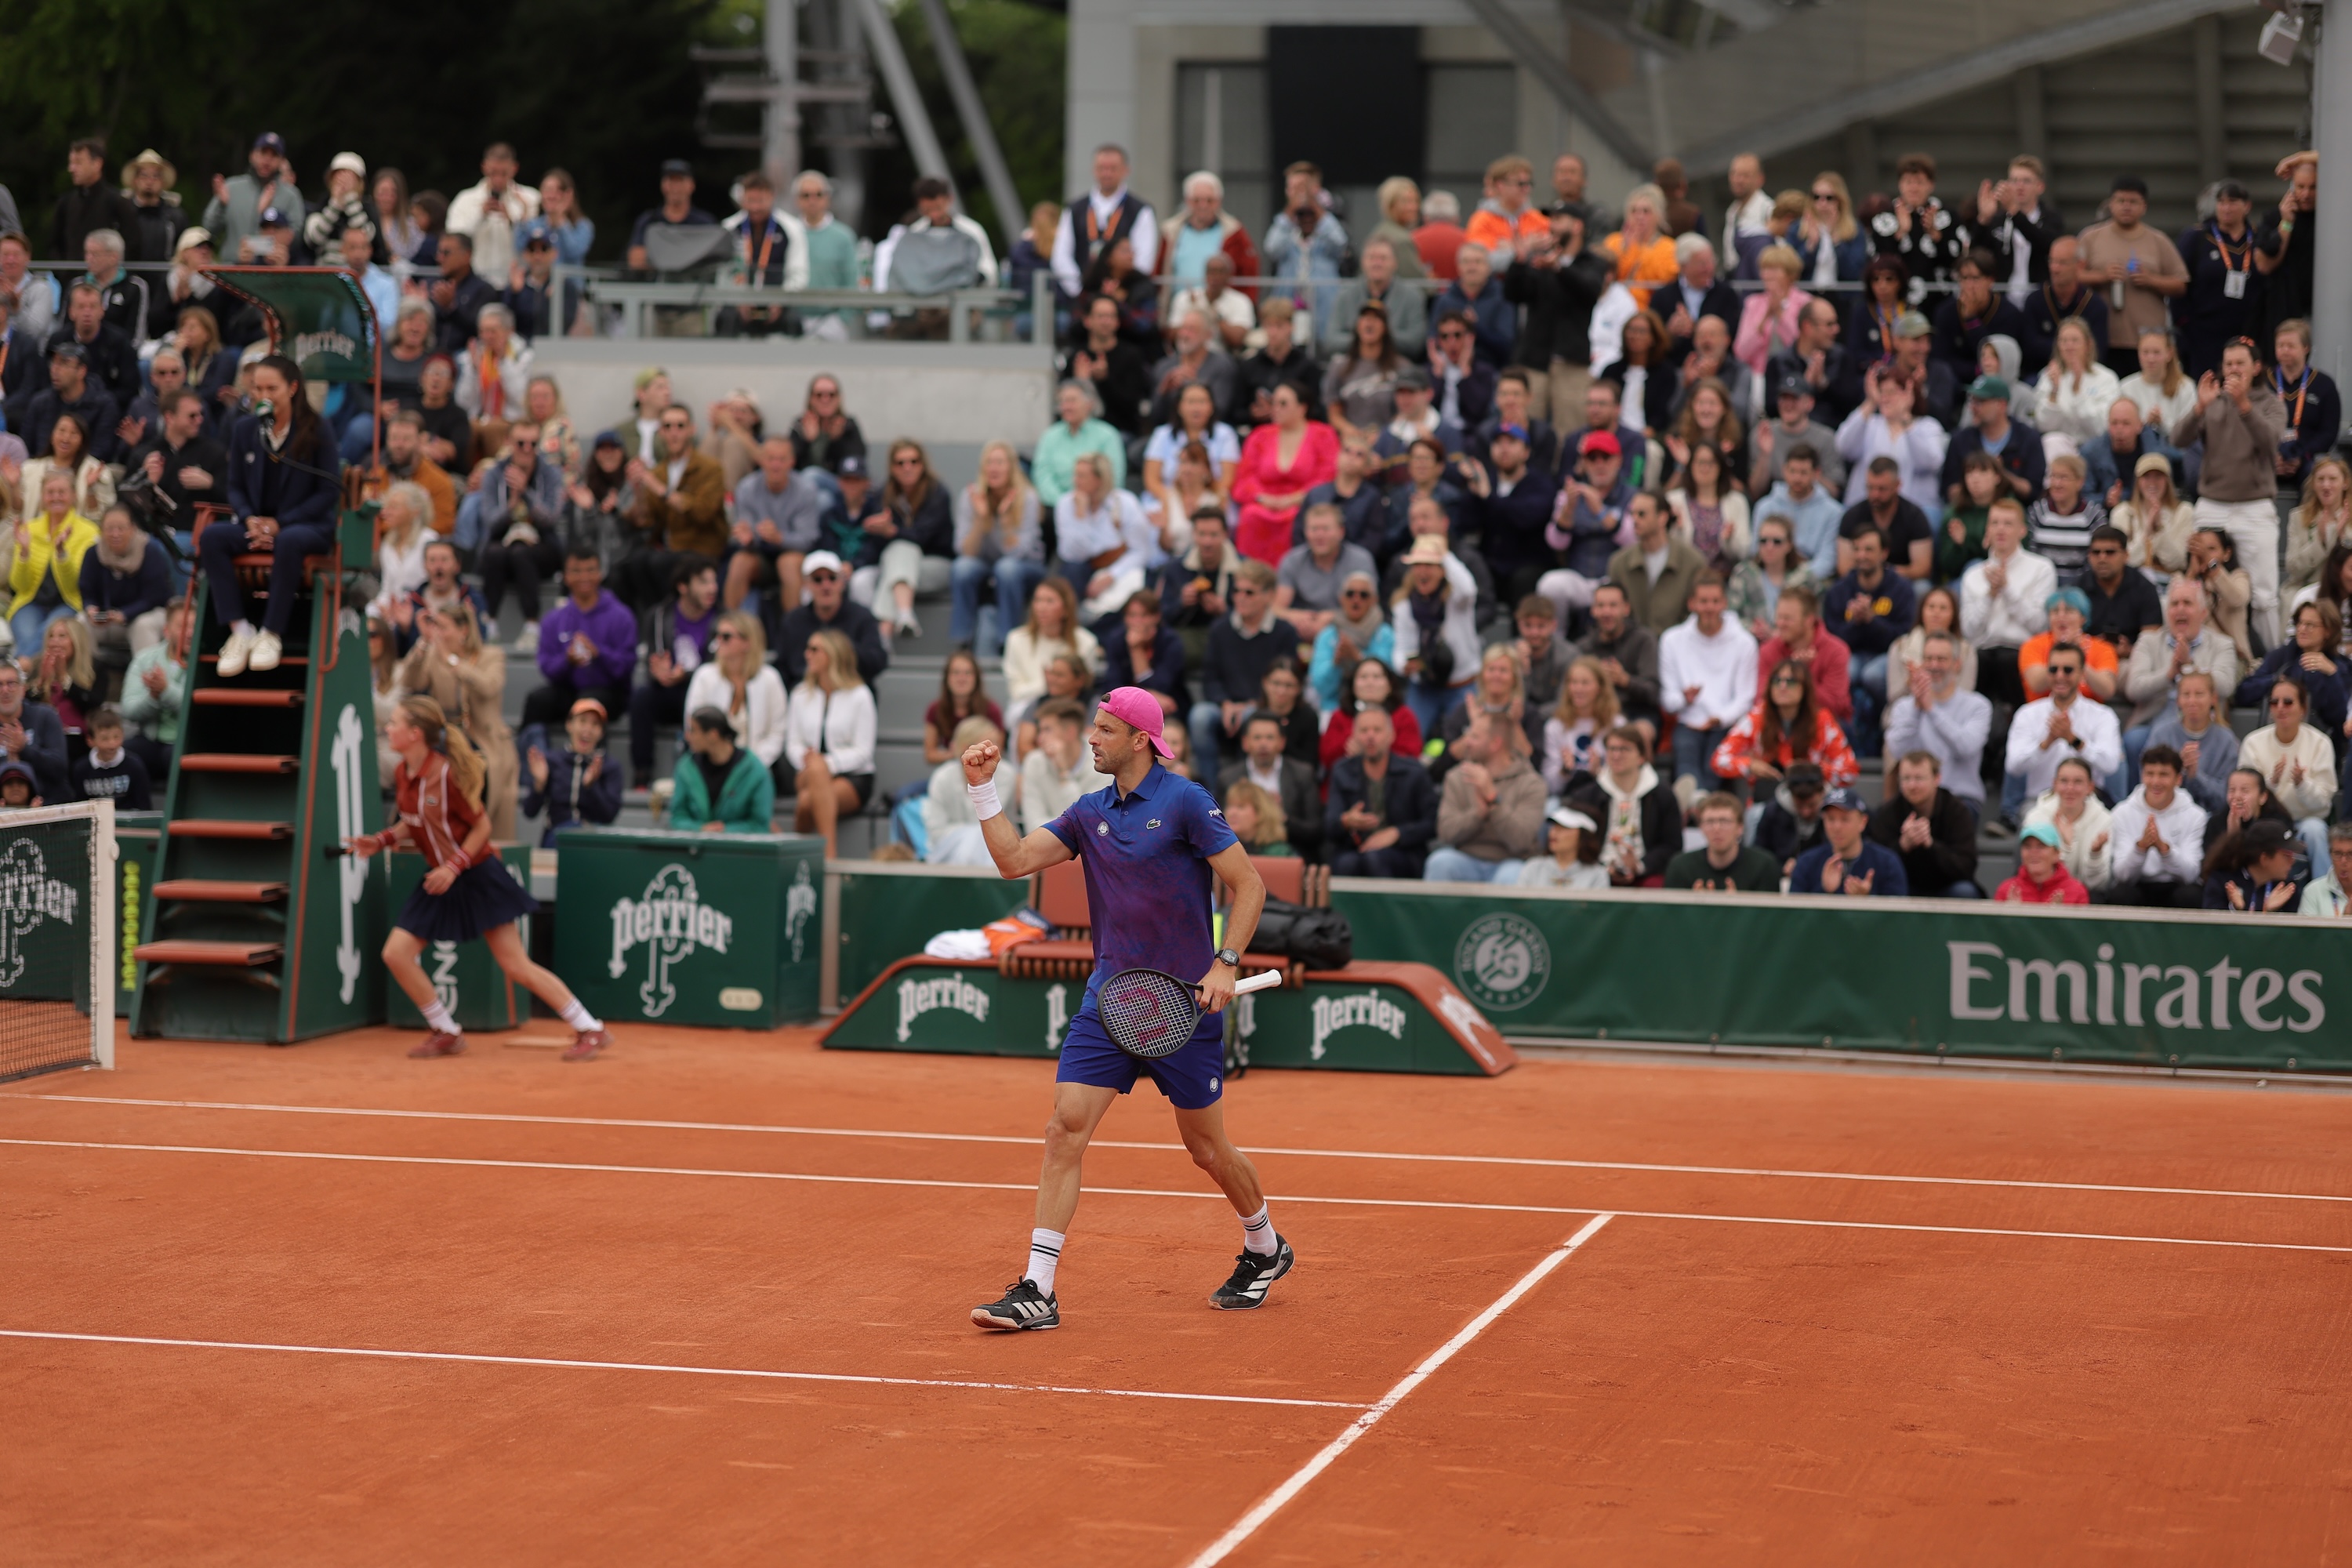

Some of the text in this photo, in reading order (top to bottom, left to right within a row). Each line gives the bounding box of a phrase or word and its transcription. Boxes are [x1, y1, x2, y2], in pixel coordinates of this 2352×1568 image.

[0, 865, 78, 925] rrier
[608, 888, 733, 978] perrier
[897, 971, 990, 1043] perrier
[1946, 941, 2326, 1033] Emirates
[1310, 988, 1406, 1060] perrier
